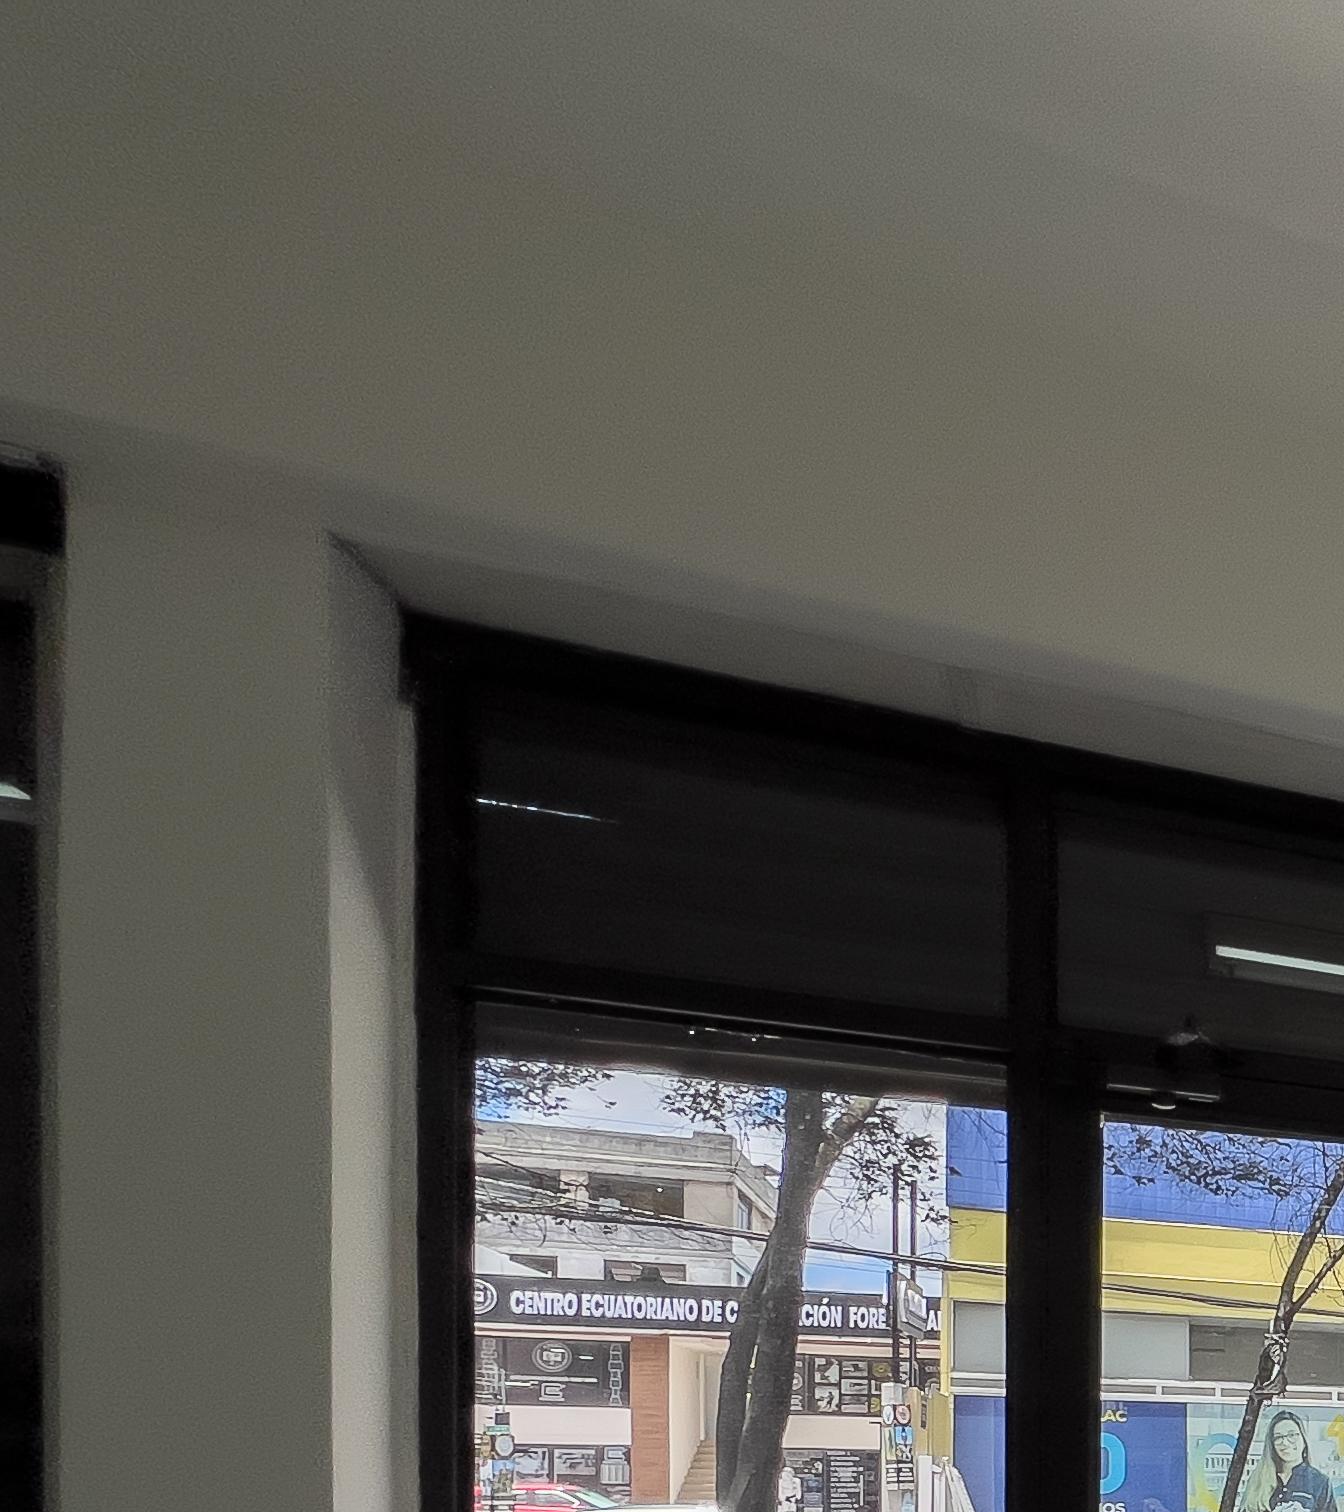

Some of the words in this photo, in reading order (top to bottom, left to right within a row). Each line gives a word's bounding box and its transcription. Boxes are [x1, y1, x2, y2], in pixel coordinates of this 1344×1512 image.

[509, 1290, 578, 1317] CENTRO
[581, 1293, 699, 1321] ECUATORIANO
[701, 1301, 722, 1323] DE
